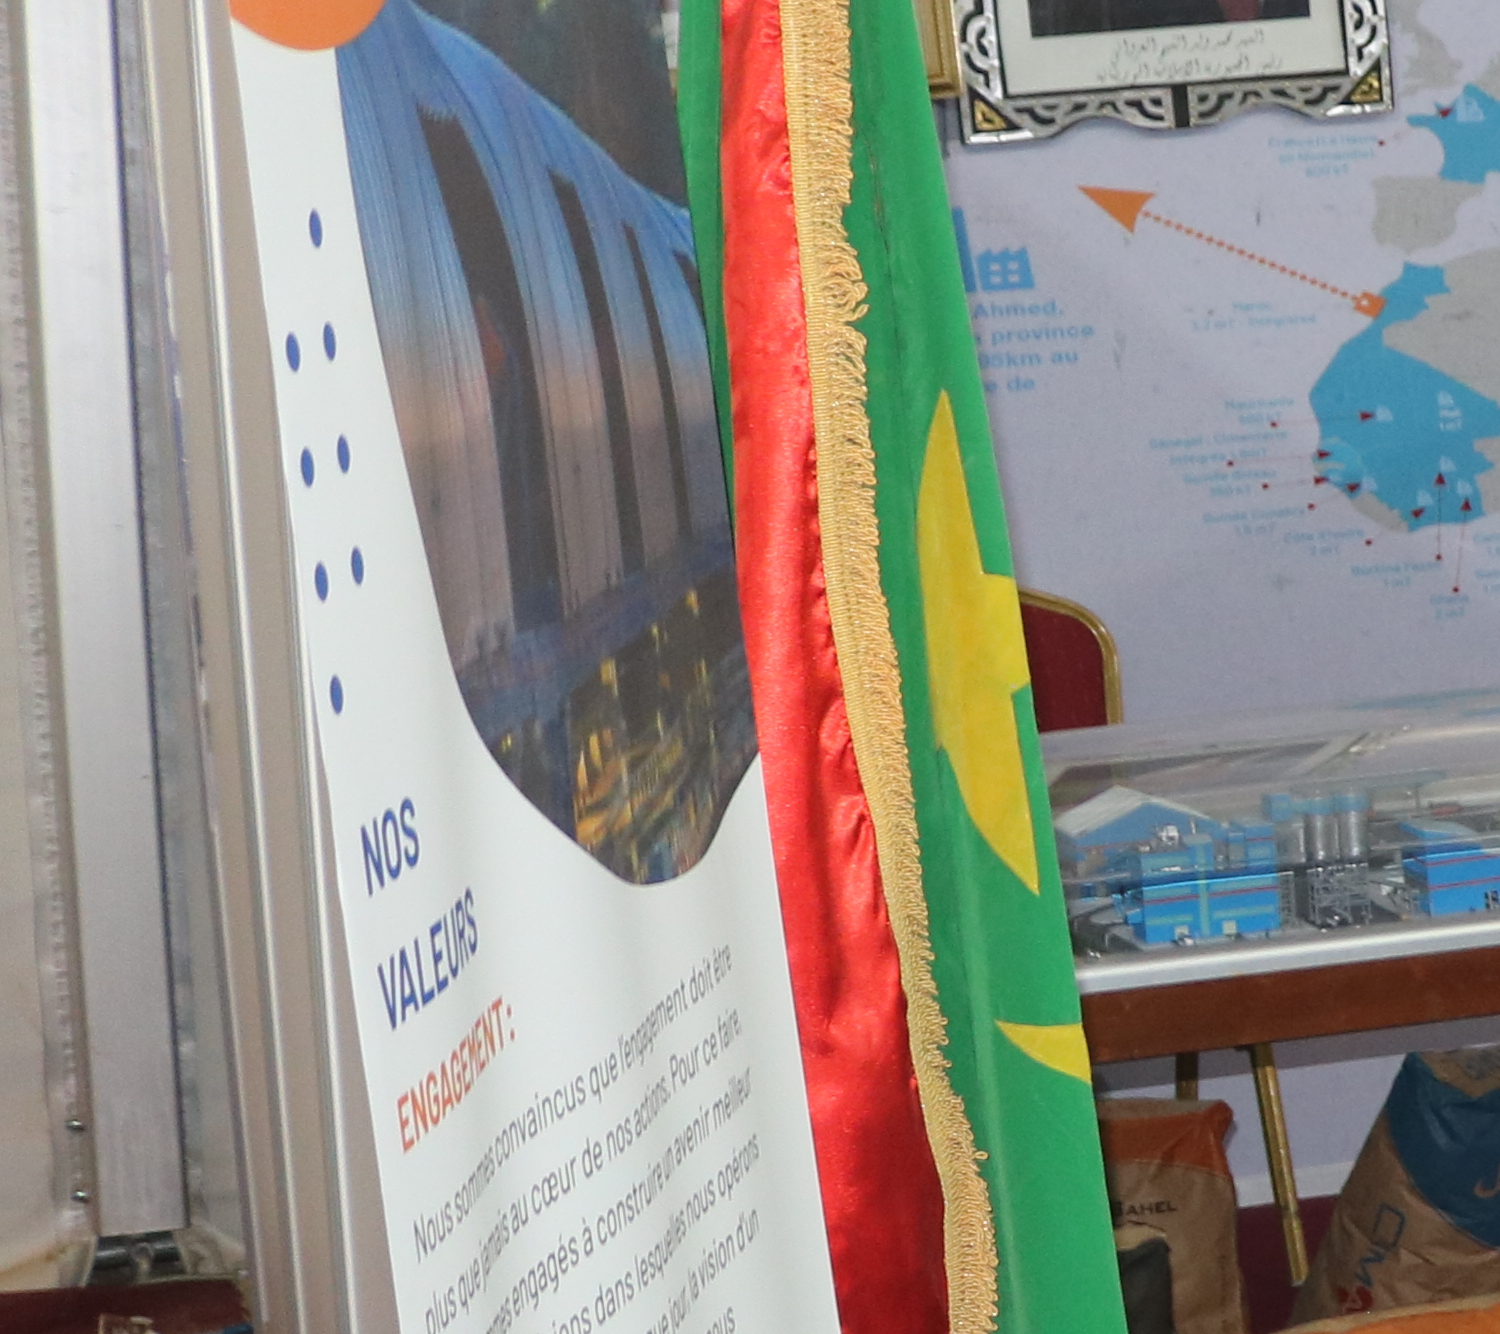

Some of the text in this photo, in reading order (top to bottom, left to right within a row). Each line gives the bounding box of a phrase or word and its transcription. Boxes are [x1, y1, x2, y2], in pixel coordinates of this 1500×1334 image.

[360, 797, 420, 898] NOS
[377, 886, 479, 1031] VALEURS
[413, 943, 734, 1265] Nous sommes convaincus que l'engagement doit être
[457, 1254, 482, 1316] que
[478, 1208, 511, 1293] jamais
[509, 1193, 530, 1236] au
[530, 1153, 578, 1216] cœur
[581, 1135, 604, 1179] de
[605, 1109, 635, 1161] nos
[668, 1047, 701, 1094] Pour
[701, 1030, 719, 1069] ce
